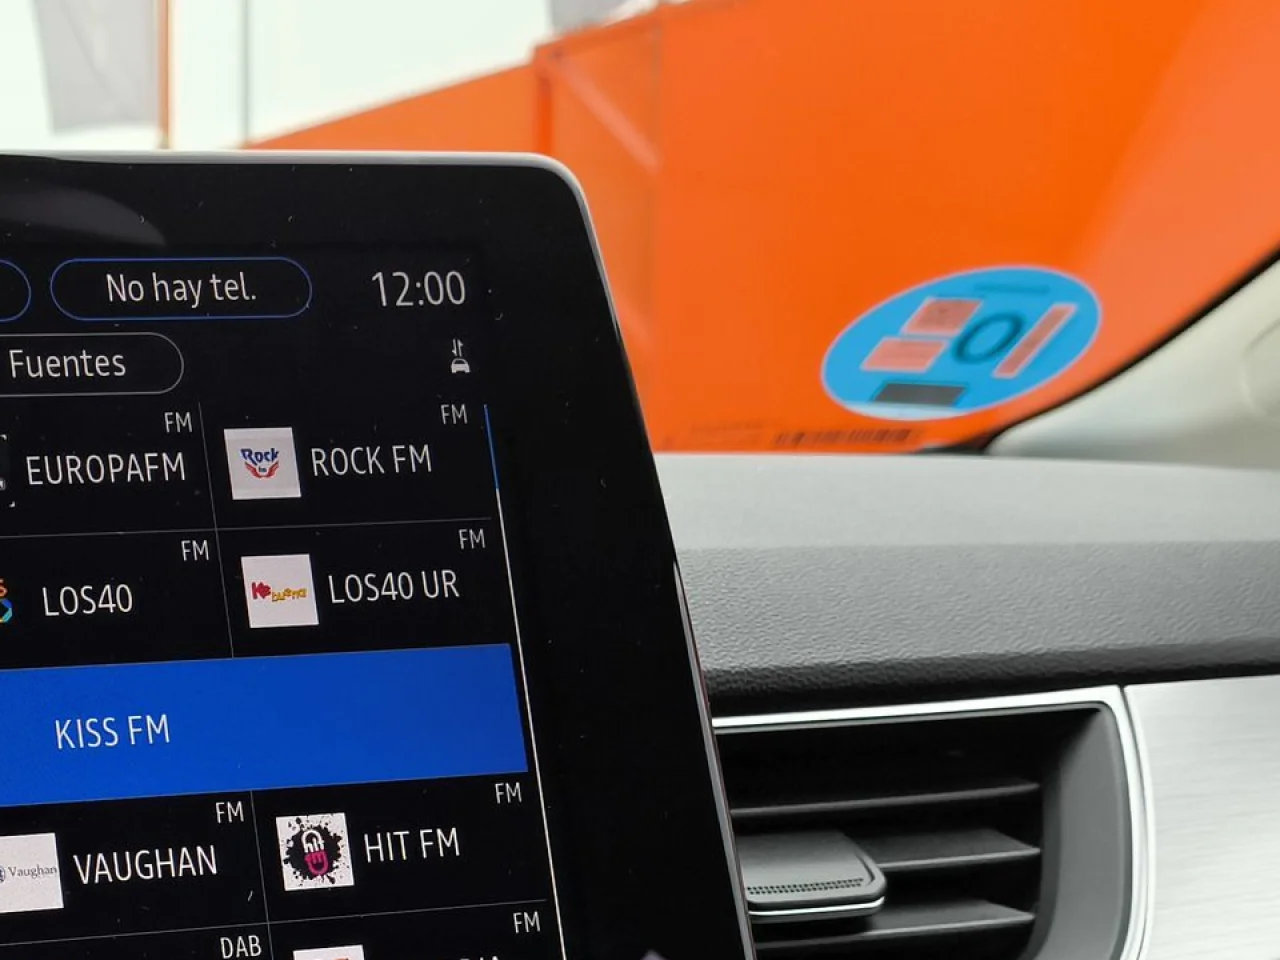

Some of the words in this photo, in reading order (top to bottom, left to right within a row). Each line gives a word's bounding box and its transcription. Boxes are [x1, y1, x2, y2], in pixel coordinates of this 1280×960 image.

[106, 273, 144, 302] No
[152, 272, 202, 309] hay
[209, 271, 256, 304] tel.
[371, 270, 466, 307] 12:00
[9, 349, 126, 378] Fuentes
[164, 411, 193, 433] FM
[440, 403, 468, 425] FM
[26, 451, 185, 485] EUROPAFM
[311, 446, 385, 477] ROCK
[391, 444, 432, 473] FM
[181, 539, 209, 561] FM
[458, 528, 485, 549] FM
[42, 583, 133, 617] LOS40
[328, 571, 414, 604] LOS40
[421, 569, 460, 599] UR
[55, 716, 121, 749] KISS
[127, 714, 170, 745] FM
[495, 782, 522, 804] FM
[215, 800, 244, 824] FM
[364, 830, 410, 863] HIT
[419, 827, 460, 859] FM
[7, 864, 58, 879] Vaughan
[72, 844, 217, 885] VAUGHAN
[513, 911, 541, 934] FM
[220, 934, 262, 959] DAB
